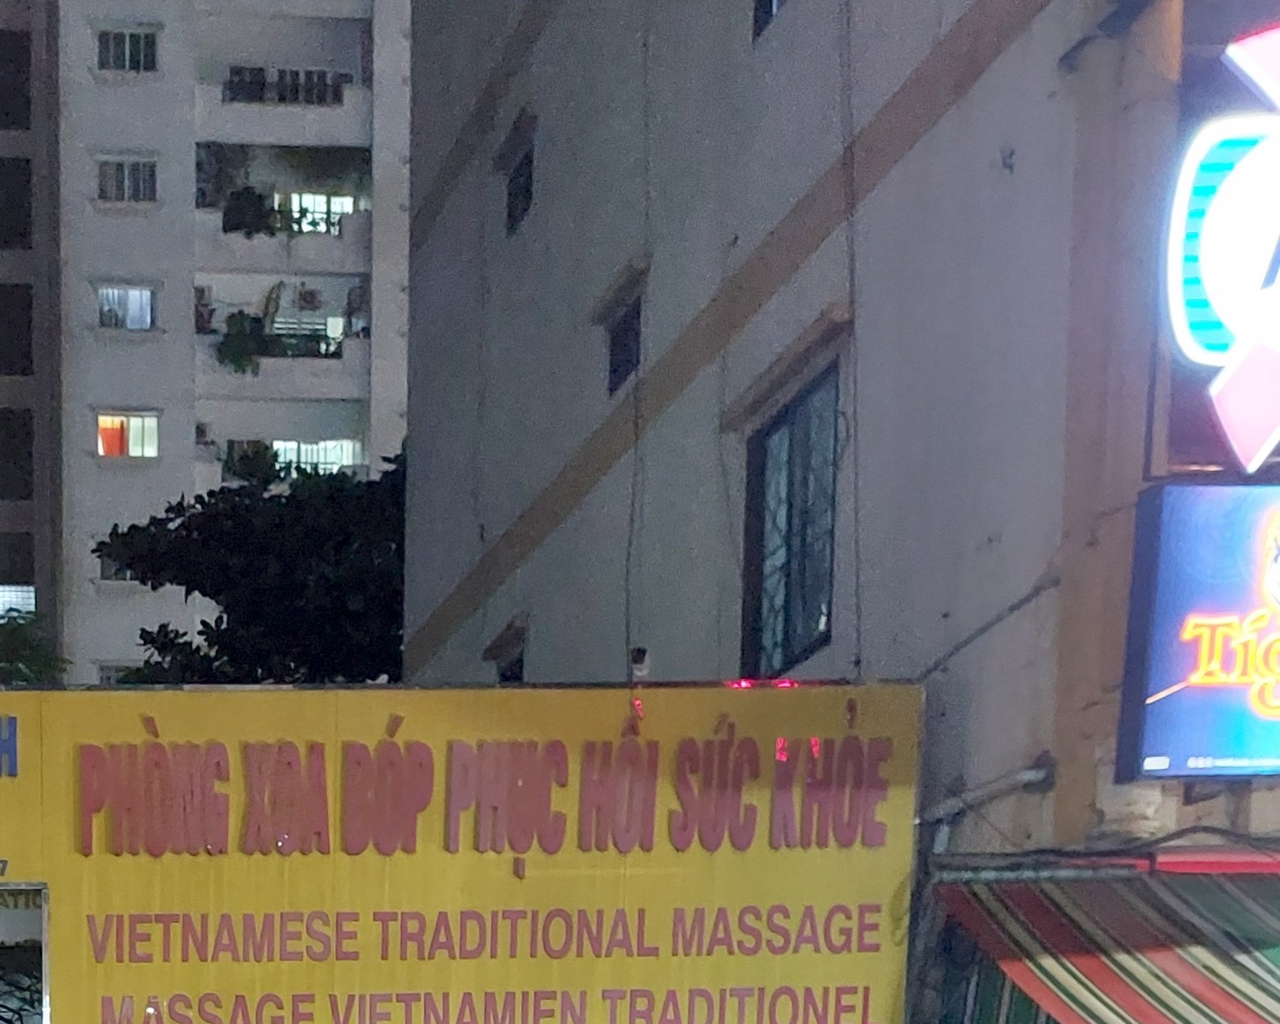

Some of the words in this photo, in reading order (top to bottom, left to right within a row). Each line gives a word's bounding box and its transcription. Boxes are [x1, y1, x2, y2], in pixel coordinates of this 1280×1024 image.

[75, 713, 232, 858] PHÒNG
[240, 740, 331, 856] XOA
[444, 739, 569, 879] PHỤC
[669, 712, 761, 852] SỨC
[86, 911, 360, 964] VIETNAMESE
[373, 907, 659, 961] TRADITIONAL
[672, 904, 882, 957] MASSAGE
